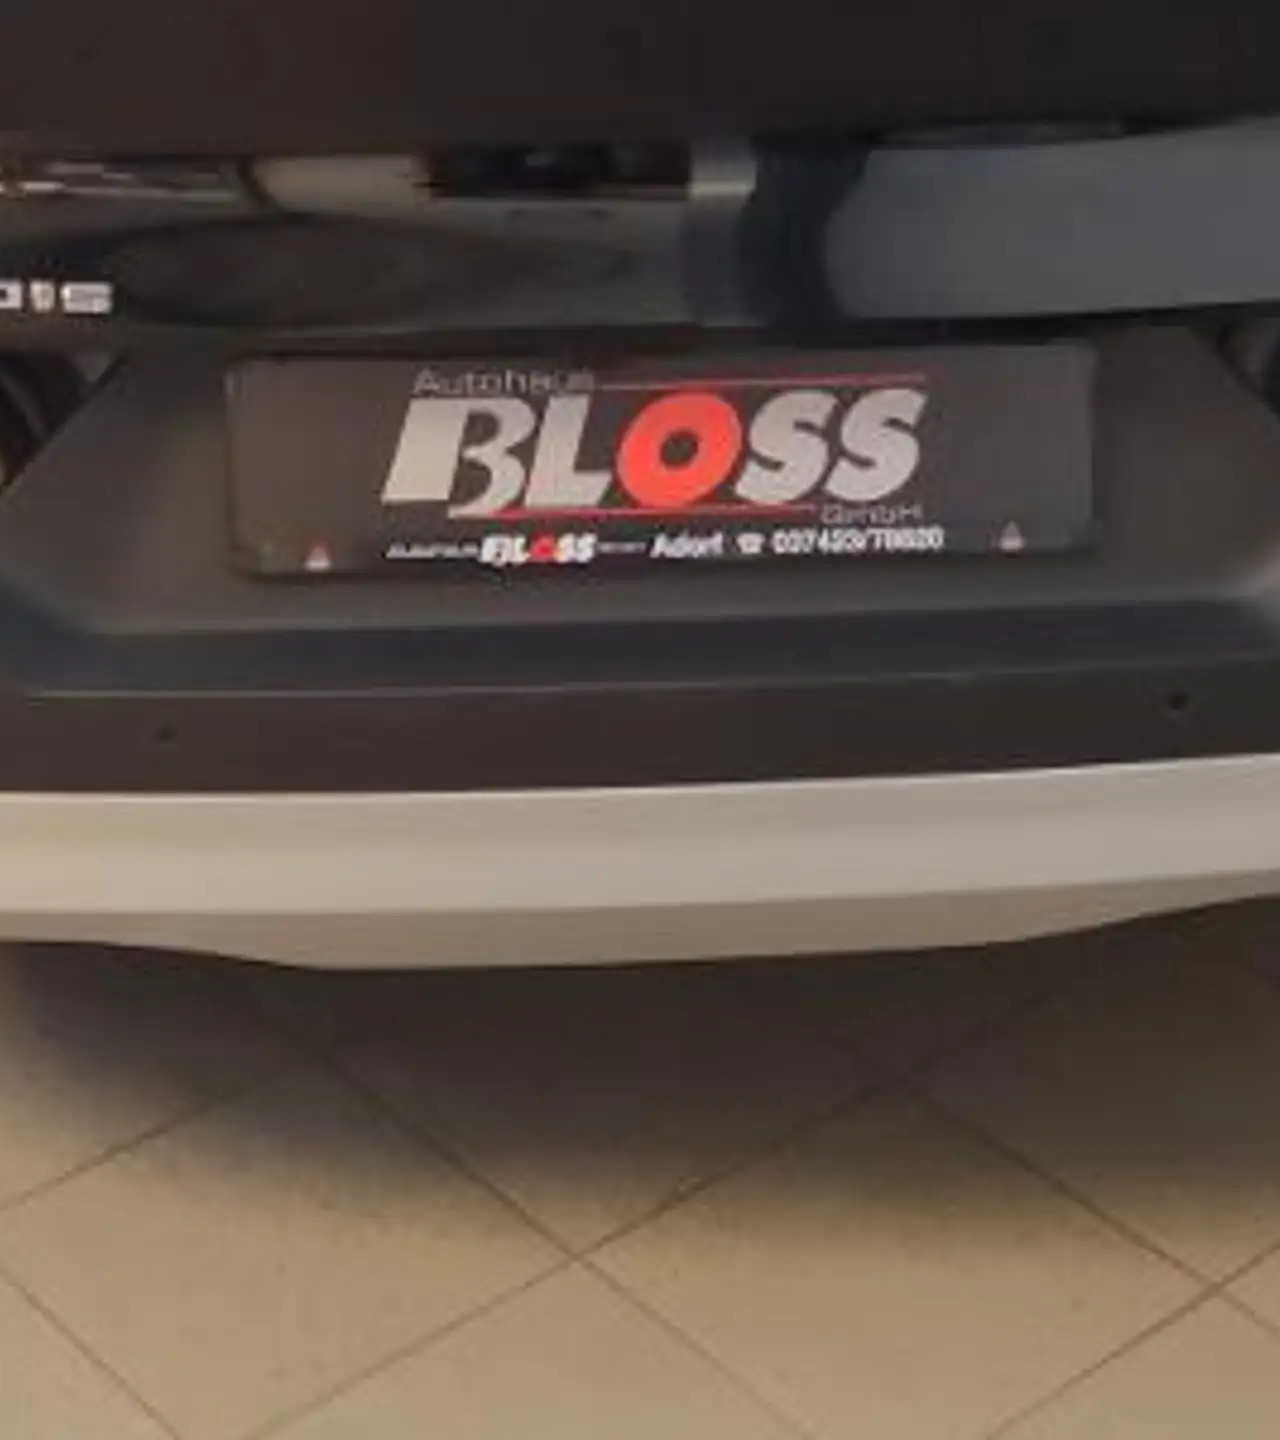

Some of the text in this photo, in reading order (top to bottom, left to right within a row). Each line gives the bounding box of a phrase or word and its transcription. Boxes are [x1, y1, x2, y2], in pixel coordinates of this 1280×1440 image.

[413, 366, 596, 395] Autohaus
[380, 387, 928, 519] BLOSS
[649, 531, 725, 559] Adorf
